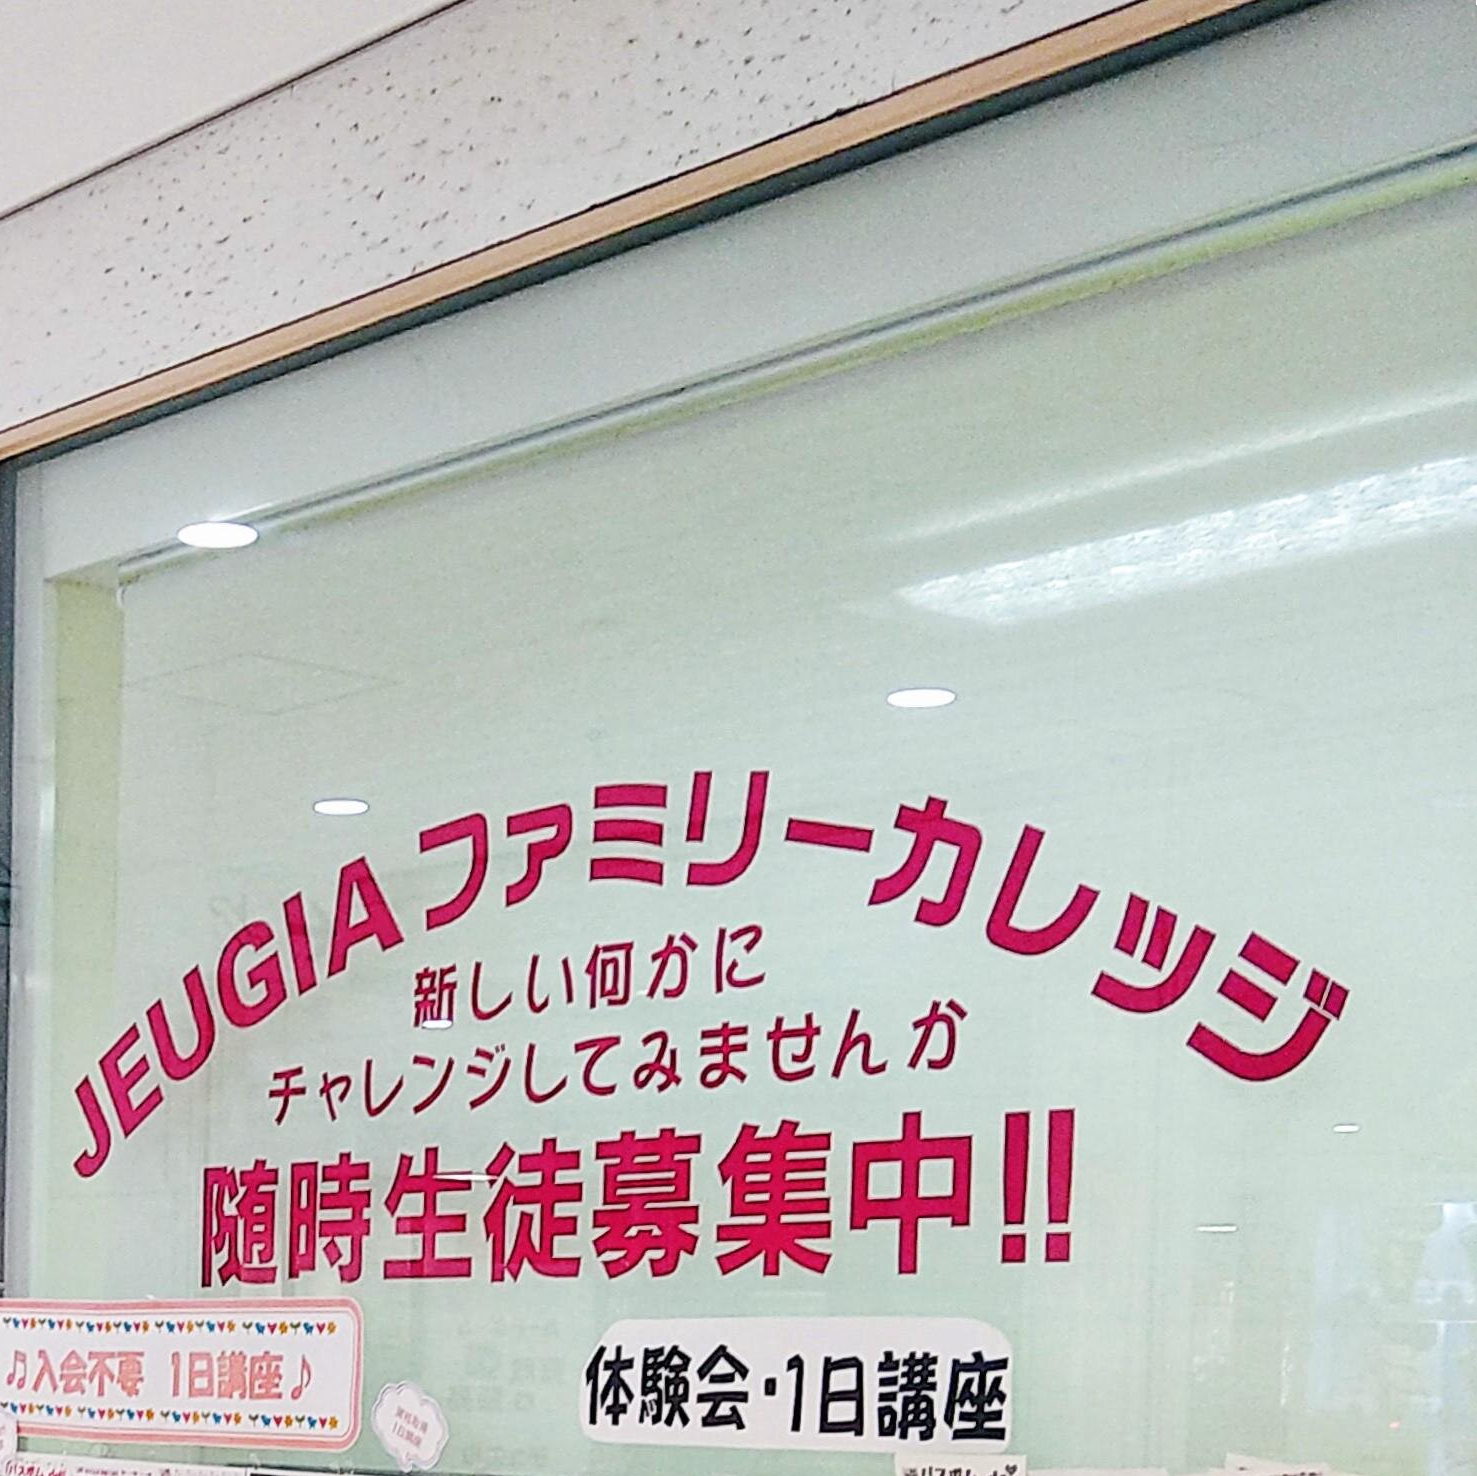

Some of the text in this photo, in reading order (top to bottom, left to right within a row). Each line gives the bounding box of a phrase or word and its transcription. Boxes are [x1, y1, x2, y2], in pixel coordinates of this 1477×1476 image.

[413, 925, 766, 1028] 新しい何かに
[268, 998, 969, 1126] チャレンジしてみませんか
[200, 1108, 1076, 1289] 随時生徒募集中!!
[32, 1350, 285, 1400] 入会不要 1日講座
[585, 1343, 1010, 1438] 体験会・1日講座
